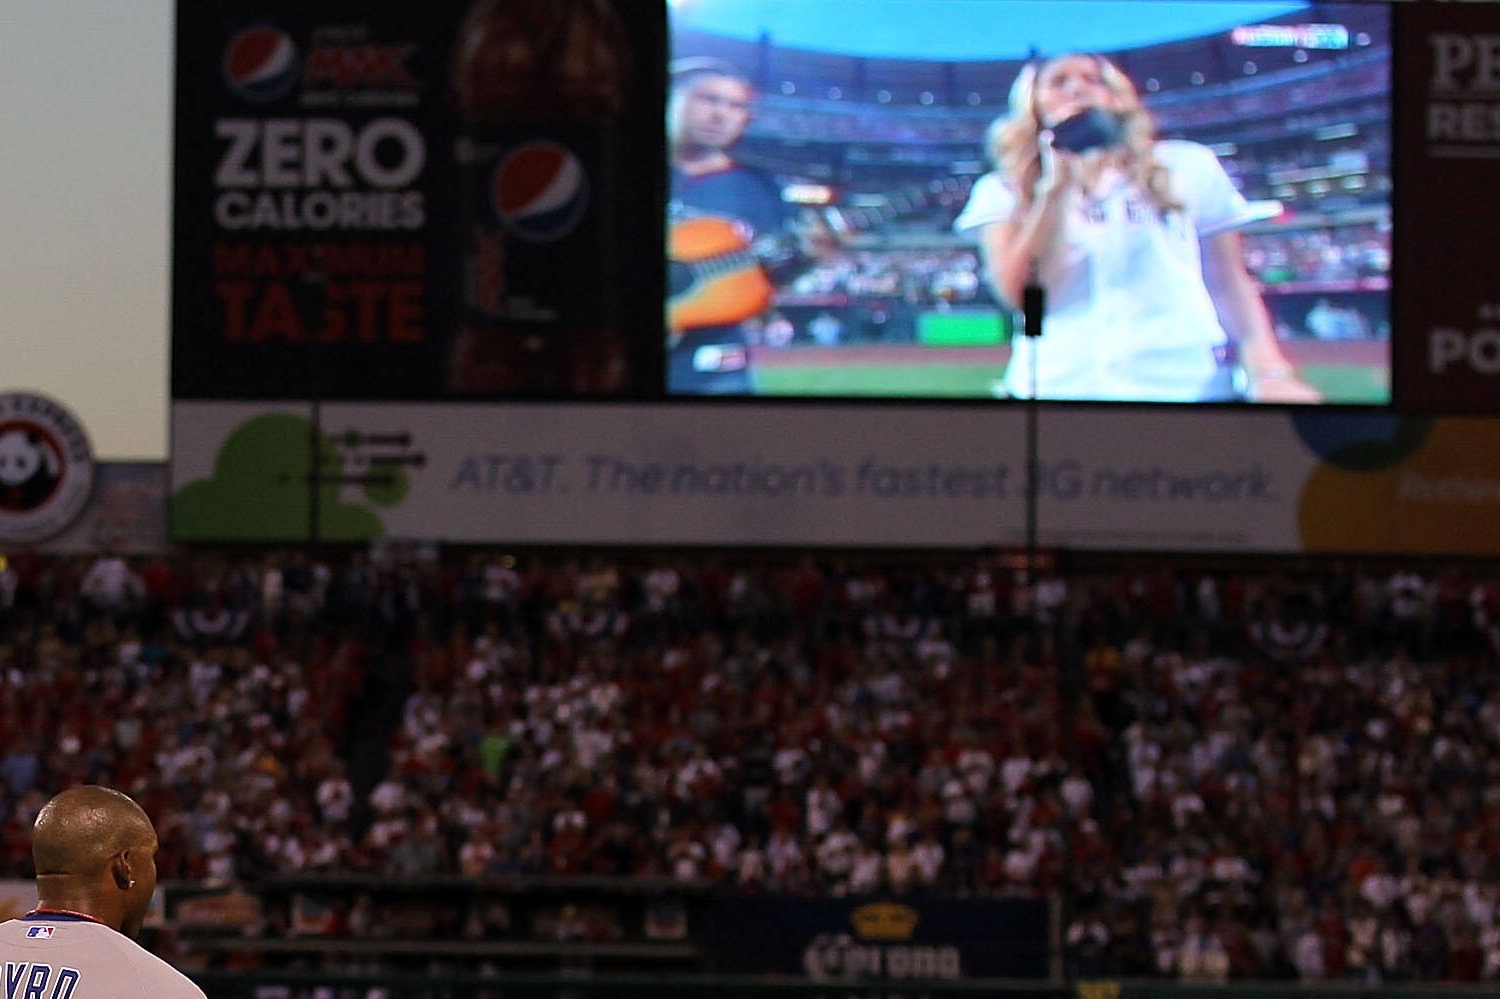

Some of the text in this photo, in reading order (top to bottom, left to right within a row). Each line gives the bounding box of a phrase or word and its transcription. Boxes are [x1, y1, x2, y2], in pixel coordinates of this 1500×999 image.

[214, 117, 426, 188] ZERO
[214, 190, 426, 230] CALORIES
[587, 453, 666, 494] The
[672, 455, 846, 497] nation's
[856, 455, 1008, 500] fastest
[803, 931, 961, 982] Corona
